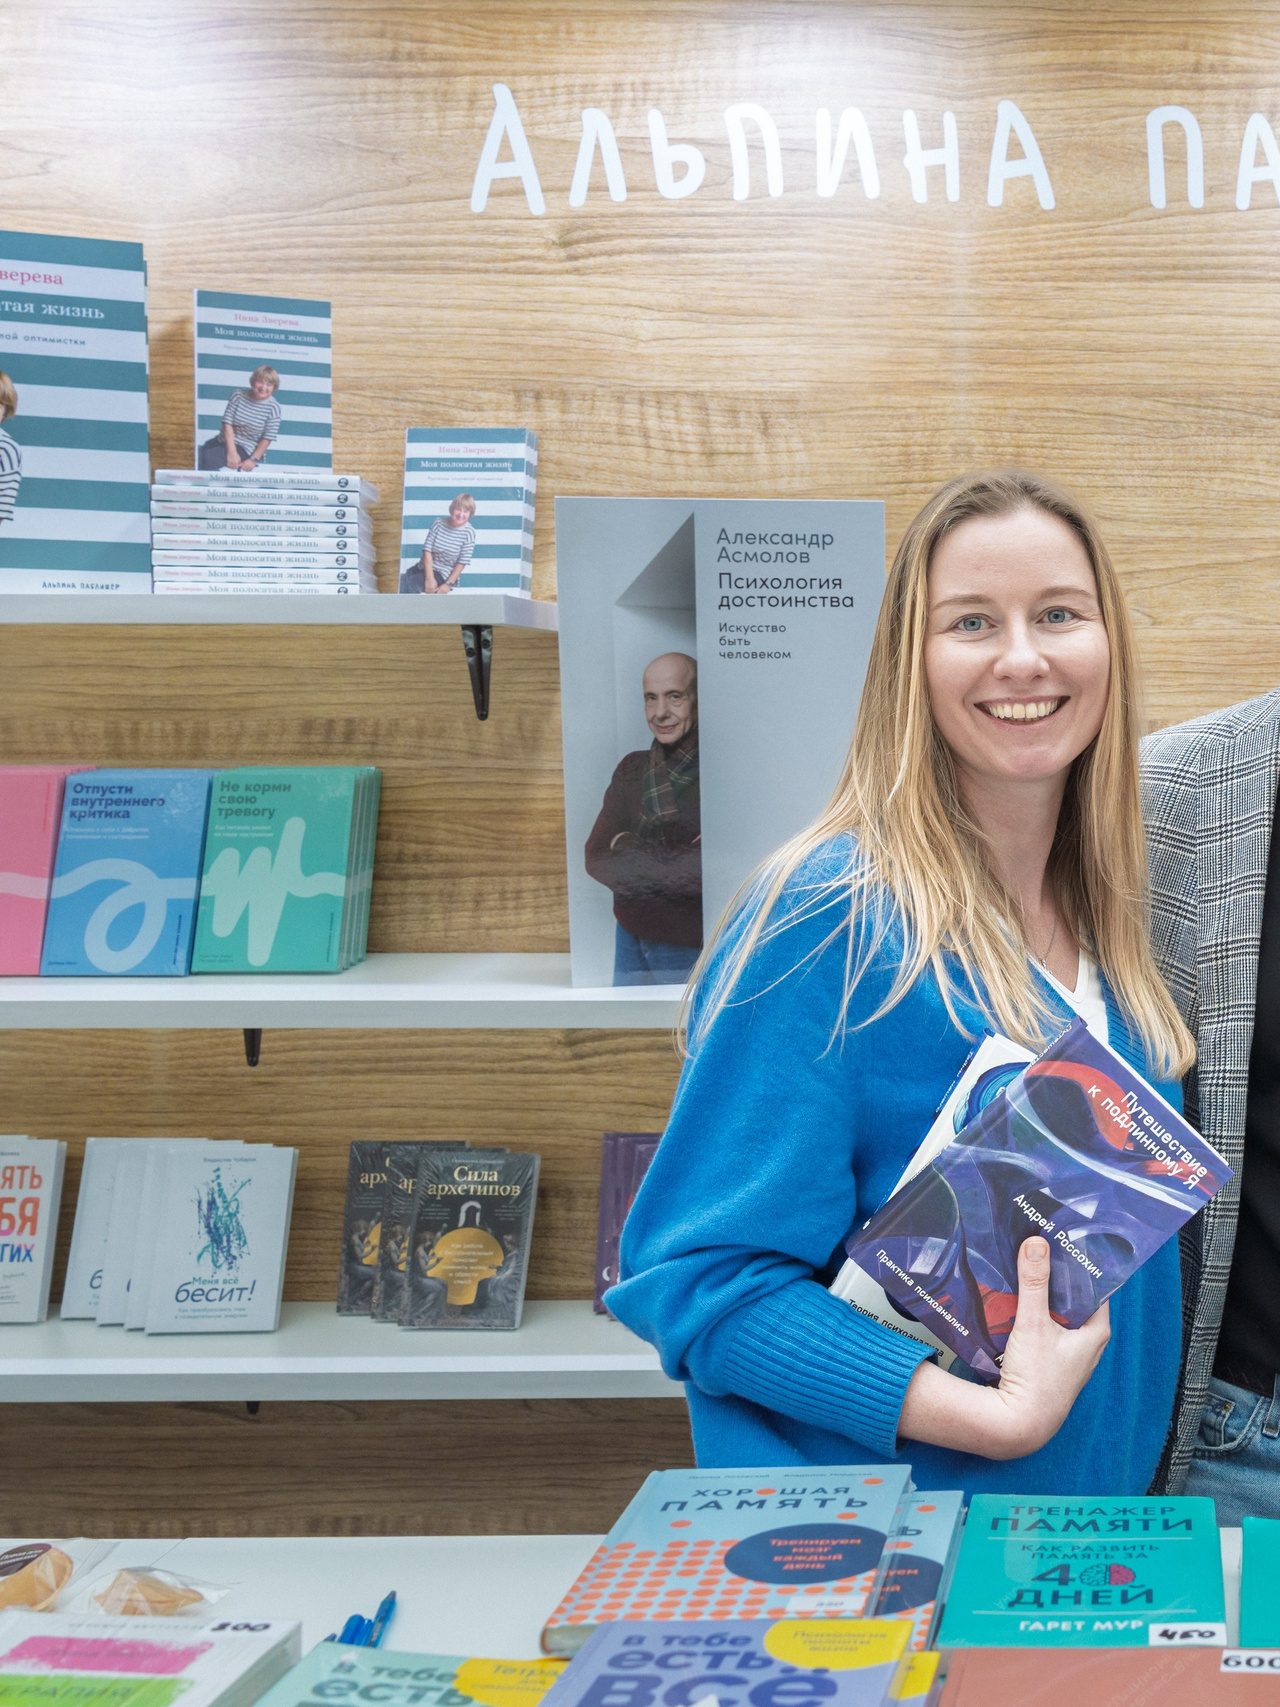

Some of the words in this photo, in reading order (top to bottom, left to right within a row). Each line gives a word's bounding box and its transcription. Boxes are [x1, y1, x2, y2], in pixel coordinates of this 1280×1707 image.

[470, 83, 1056, 216] АЛЬПИНА
[0, 269, 63, 286] верева
[41, 303, 105, 319] жизнь
[23, 335, 87, 346] оптимистки
[214, 326, 234, 336] Моя
[237, 330, 286, 341] полосатая
[288, 334, 319, 343] жизнь
[209, 474, 230, 483] Моя
[206, 490, 228, 498] Моя
[205, 505, 226, 514] Моя
[206, 522, 228, 530] Моя
[716, 528, 834, 550] Александр
[716, 546, 811, 564] Асмолов
[718, 572, 843, 590] Психология
[718, 594, 855, 610] достоинства
[718, 622, 787, 635] Искусство
[718, 636, 751, 647] быть
[718, 650, 792, 660] человеком
[72, 782, 134, 794] Отпусти
[220, 782, 240, 792] Не
[244, 782, 292, 795] корми
[70, 796, 166, 809] внутреннего
[218, 795, 258, 805] свою
[70, 808, 130, 820] критика
[217, 807, 276, 820] тревогу
[1120, 1090, 1208, 1178] Путешествие
[1100, 1096, 1184, 1177] подлинному
[1182, 1174, 1200, 1190] Я
[0, 1165, 42, 1190] ЯТЬ
[454, 1166, 498, 1182] Сила
[427, 1183, 521, 1200] архетипов
[0, 1196, 40, 1236] БЯ
[1013, 1194, 1056, 1234] Андрей
[1054, 1230, 1103, 1278] Россохин
[192, 1277, 220, 1285] Меня
[174, 1280, 256, 1303] бесит!
[876, 1249, 915, 1287] Практика
[914, 1285, 970, 1337] психоанализа
[848, 1299, 880, 1322] Теория
[660, 1497, 868, 1512] ПАМЯТЬ
[1010, 1505, 1177, 1516] ТРЕНАЖЕР
[990, 1517, 1193, 1532] ПАМЯТИ
[768, 1538, 862, 1546] Тренируем
[1022, 1544, 1062, 1552] КАК
[1071, 1544, 1160, 1552] РАЗВИТЬ
[792, 1546, 832, 1554] мозг
[1032, 1552, 1115, 1560] ПАМЯТЬ
[1125, 1552, 1149, 1560] ЗА
[773, 1553, 843, 1562] каждый
[782, 1562, 826, 1570] день
[1007, 1584, 1154, 1608] ДНЕЙ
[1019, 1620, 1086, 1632] ГАРЕТ
[1093, 1620, 1144, 1631] МУР
[661, 1632, 754, 1647] тебе
[606, 1650, 775, 1670] есть
[0, 1686, 134, 1698] ЕРАПИЯ
